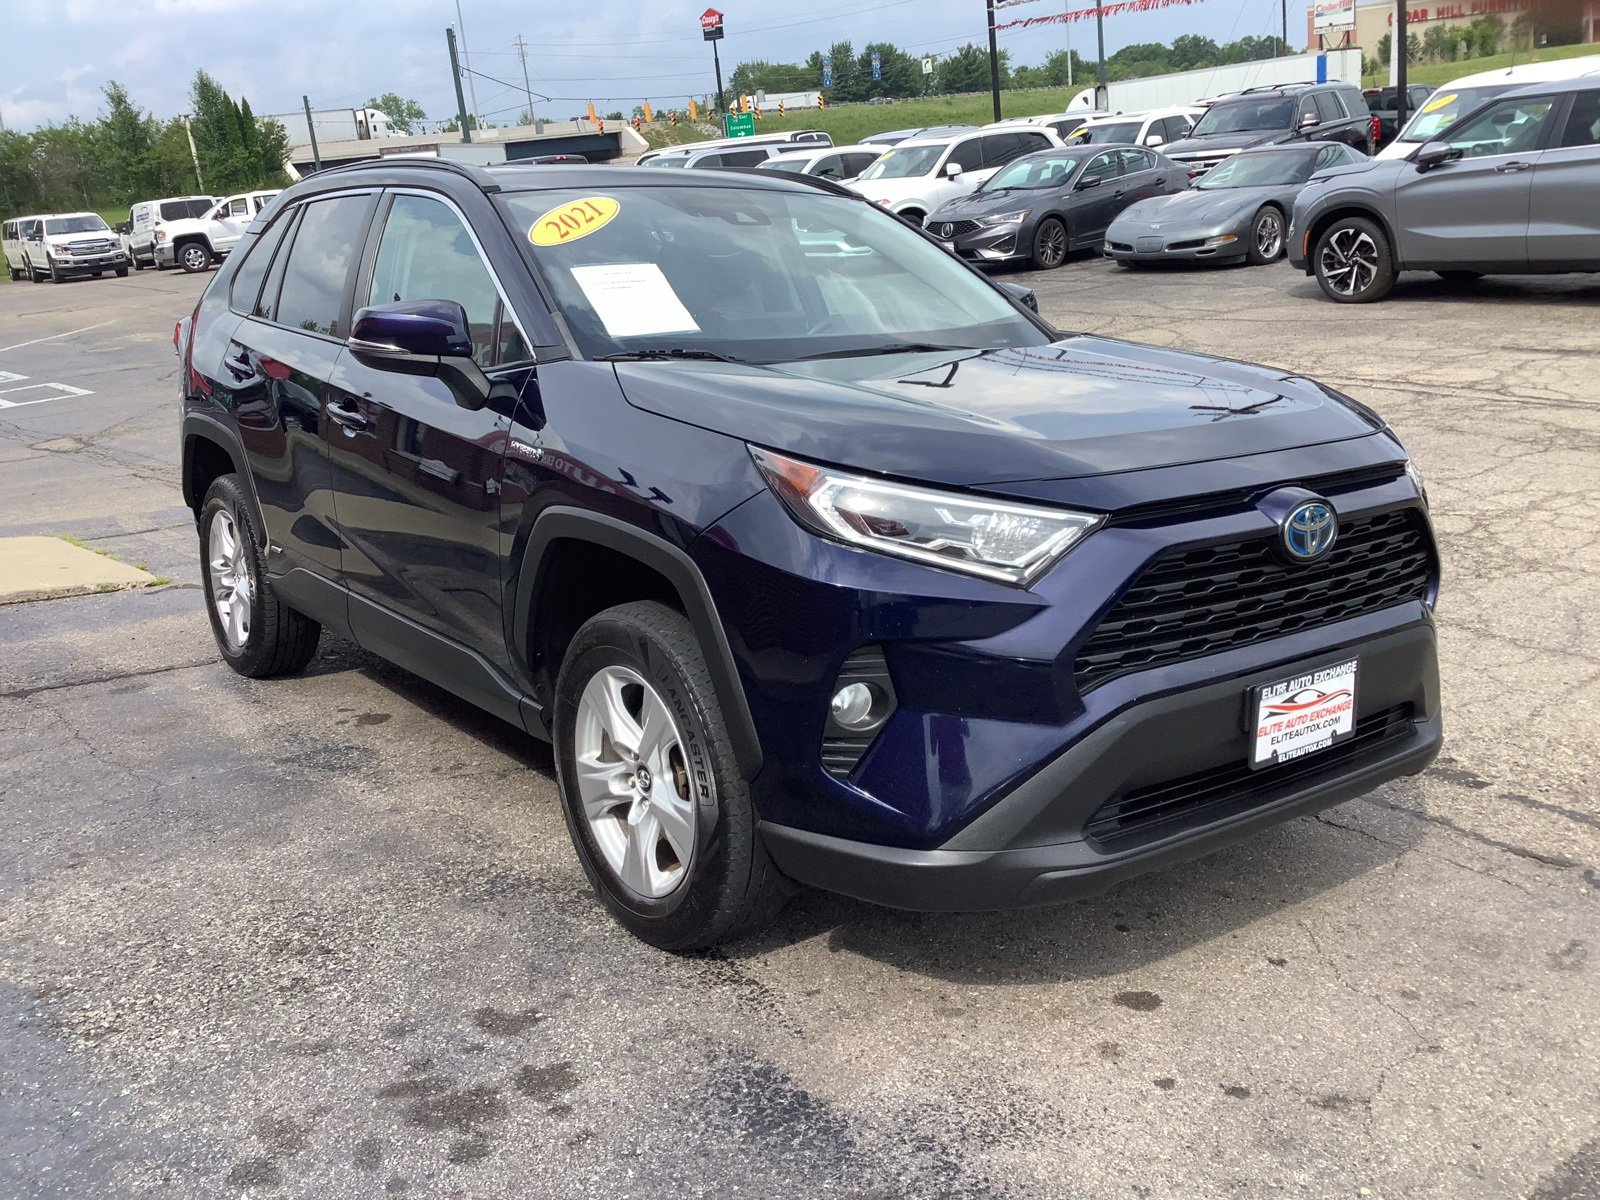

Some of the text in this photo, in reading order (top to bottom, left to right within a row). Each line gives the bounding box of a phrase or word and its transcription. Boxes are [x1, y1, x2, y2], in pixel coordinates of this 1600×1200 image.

[701, 14, 719, 24] Casey's
[545, 200, 604, 239] 2021
[1262, 661, 1358, 699] ELITE AUTO EXCHANGE
[661, 675, 710, 799] LANCASTER
[1257, 700, 1352, 738] ELITE AUTO EXCHANGE
[1271, 716, 1341, 746] ELITEAUTOX.COM
[1278, 736, 1333, 763] ELITEAUTOX.COM
